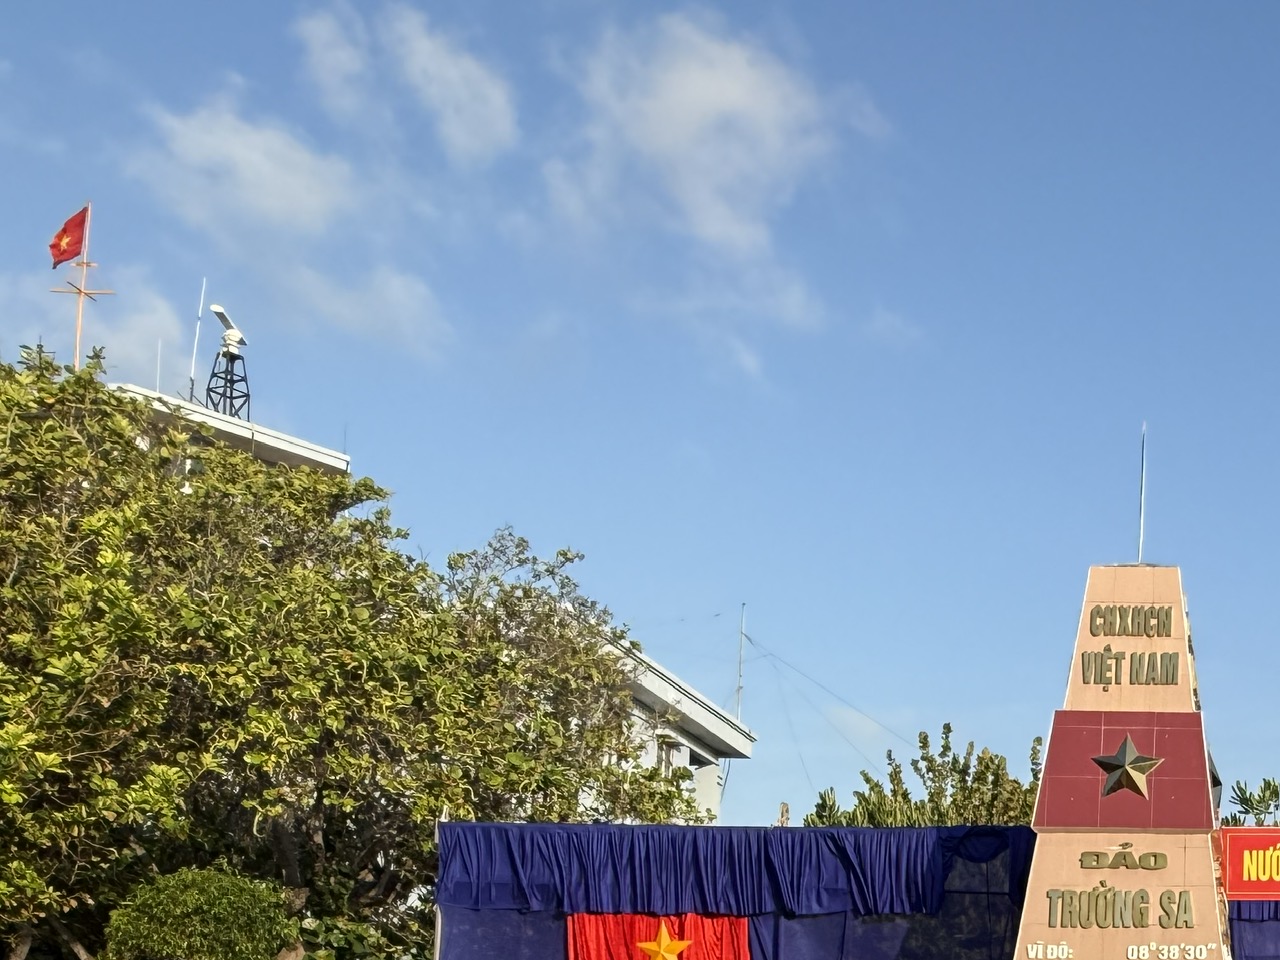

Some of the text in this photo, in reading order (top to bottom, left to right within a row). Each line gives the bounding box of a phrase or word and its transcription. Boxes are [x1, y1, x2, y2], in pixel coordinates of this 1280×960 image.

[1090, 605, 1172, 637] CHXHCN
[1082, 644, 1179, 692] VIỆT NAM
[1079, 842, 1168, 870] ĐẢO
[1047, 880, 1194, 929] TRƯỜNG SA
